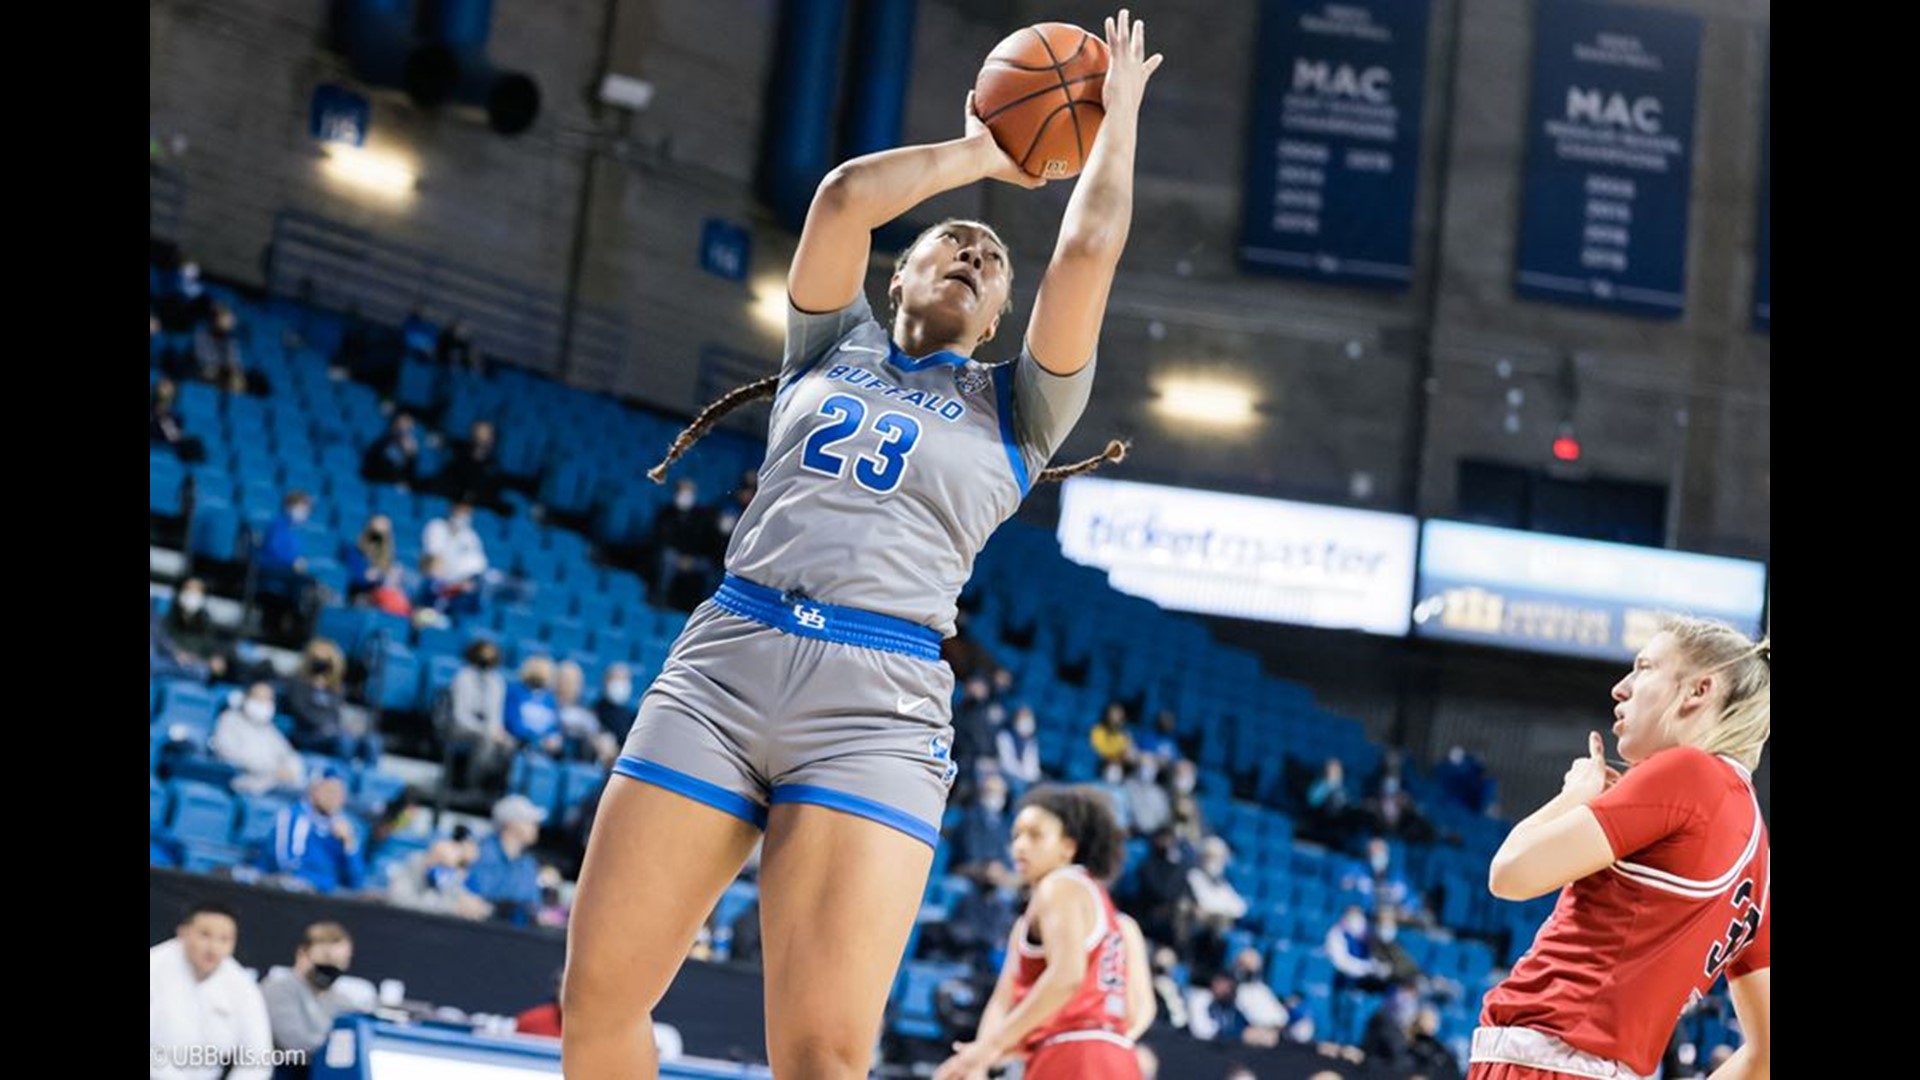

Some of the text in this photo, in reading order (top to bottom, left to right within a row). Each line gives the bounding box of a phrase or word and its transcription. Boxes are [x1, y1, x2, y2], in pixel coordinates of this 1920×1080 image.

[1293, 58, 1391, 102] MAC
[1567, 85, 1662, 133] MAC
[826, 364, 966, 423] BUFFALO
[800, 392, 922, 494] 23
